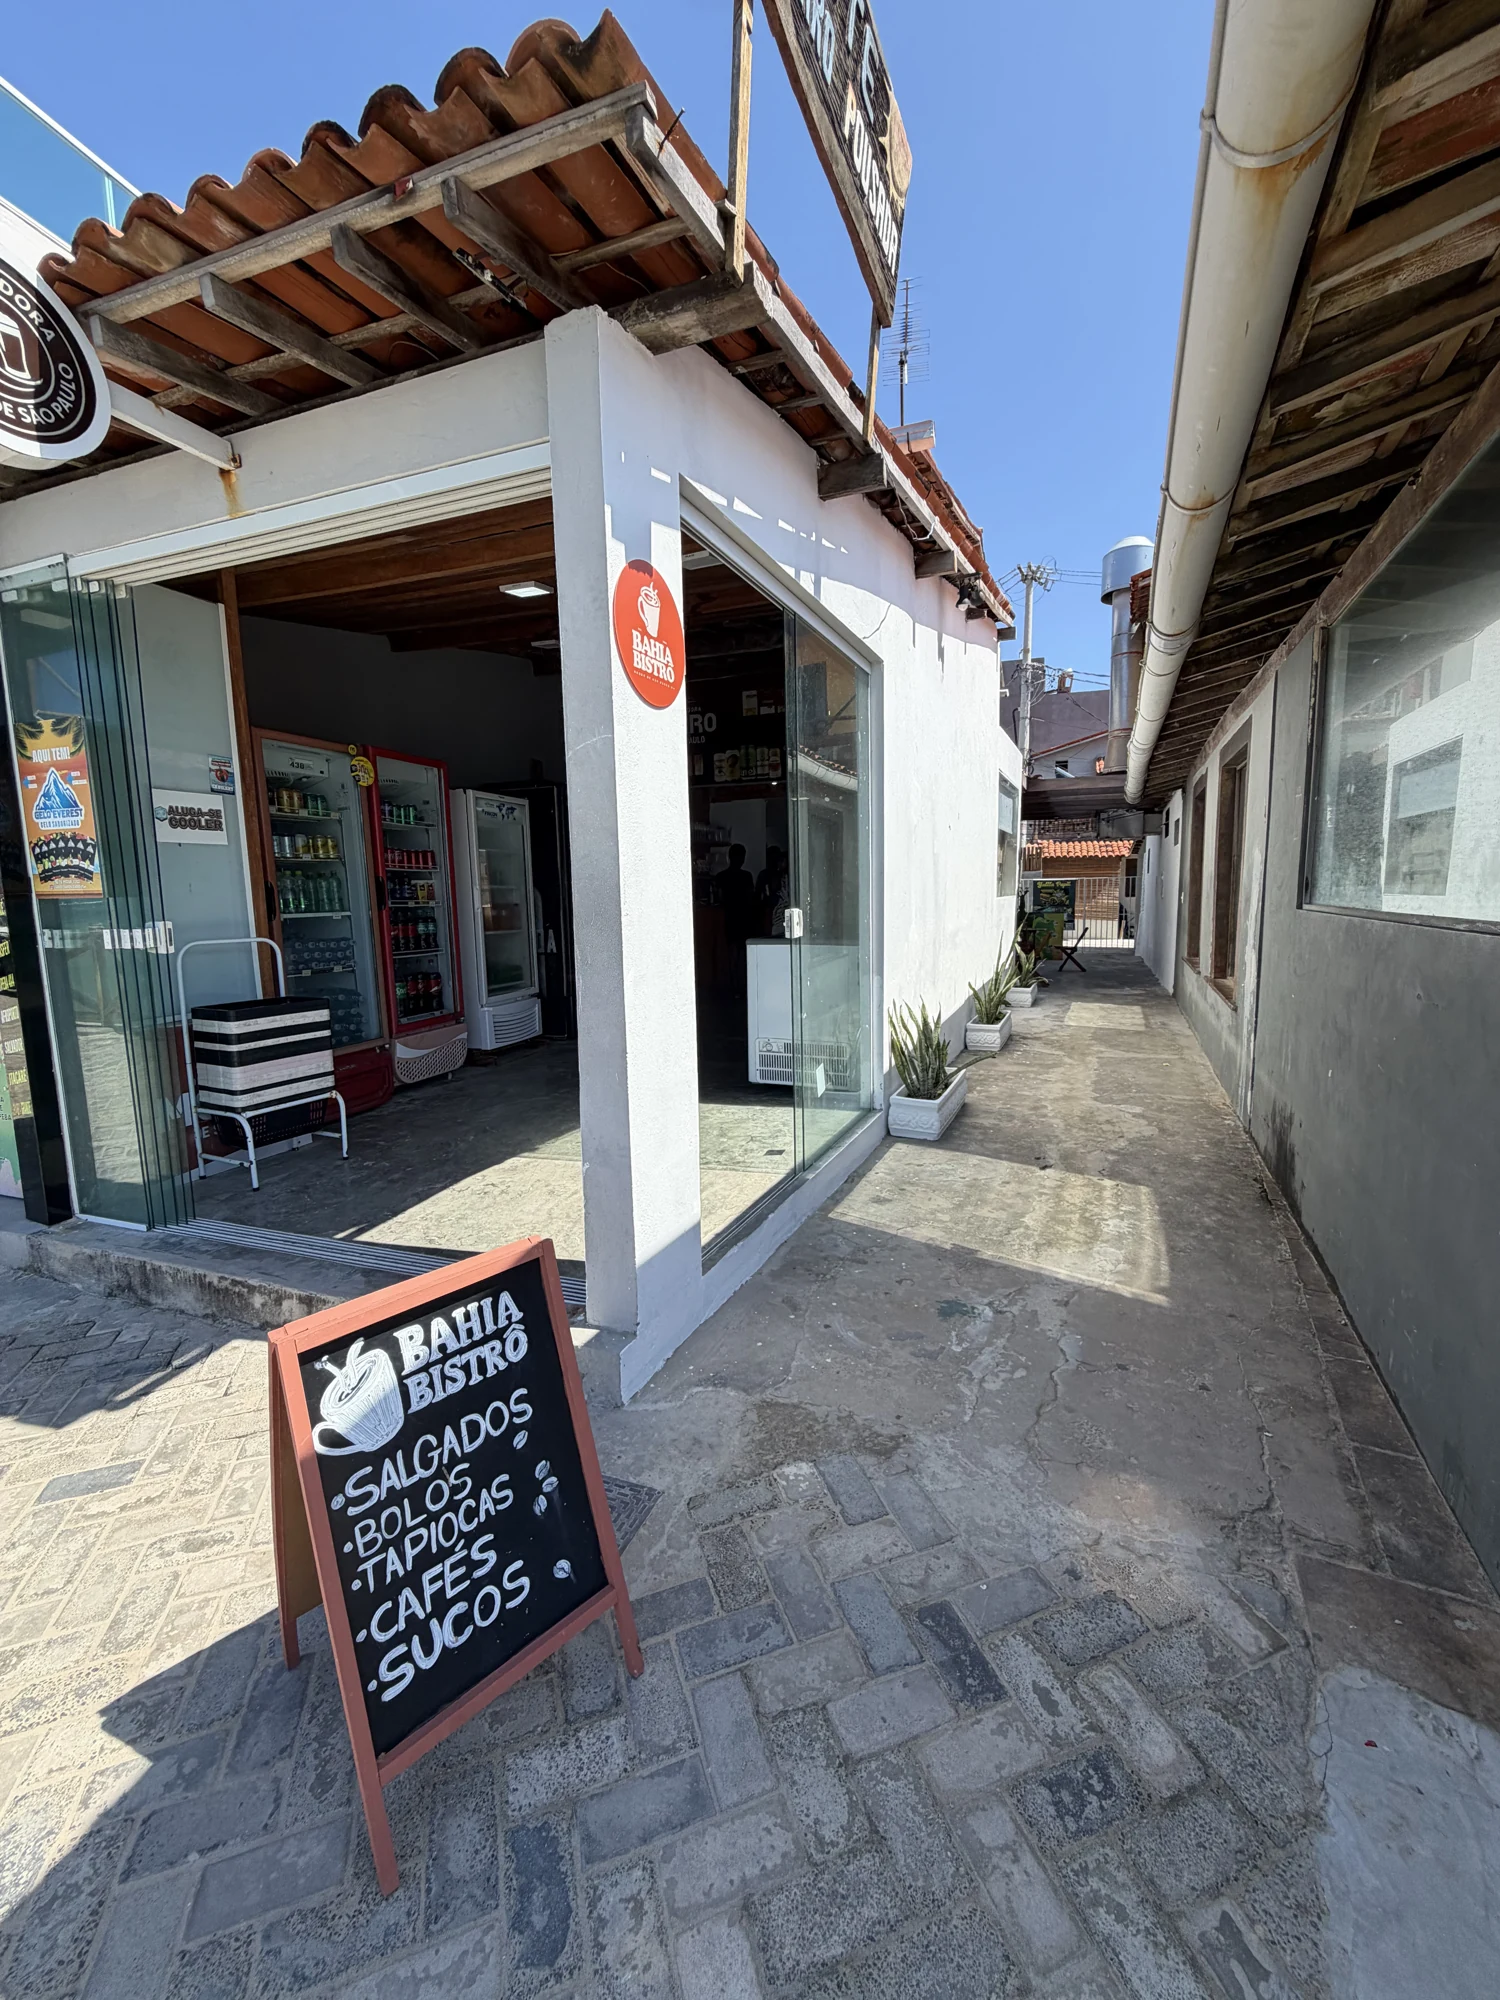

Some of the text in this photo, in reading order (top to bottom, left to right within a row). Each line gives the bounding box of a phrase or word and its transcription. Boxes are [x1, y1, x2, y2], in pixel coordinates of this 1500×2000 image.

[844, 80, 898, 277] POUSADA
[0, 278, 56, 342] DORA
[17, 404, 56, 425] SÃO
[53, 363, 76, 420] PAULO
[631, 629, 674, 666] BAHIA
[632, 650, 675, 684] BISTRÔ
[32, 746, 71, 763] AQUI TEM!
[689, 712, 717, 734] RO
[34, 808, 83, 820] GELO EVEREST
[167, 805, 223, 820] ALUGA-SE
[168, 816, 224, 832] COOLER
[393, 1290, 525, 1376] BAHIA
[403, 1322, 529, 1415] BISTRÔ
[345, 1387, 533, 1516] SALGADOS
[355, 1463, 472, 1558] BOLOS
[357, 1473, 514, 1594] TAPIOCAS
[369, 1533, 495, 1643] CAFÉS
[378, 1559, 530, 1702] SUCOS
